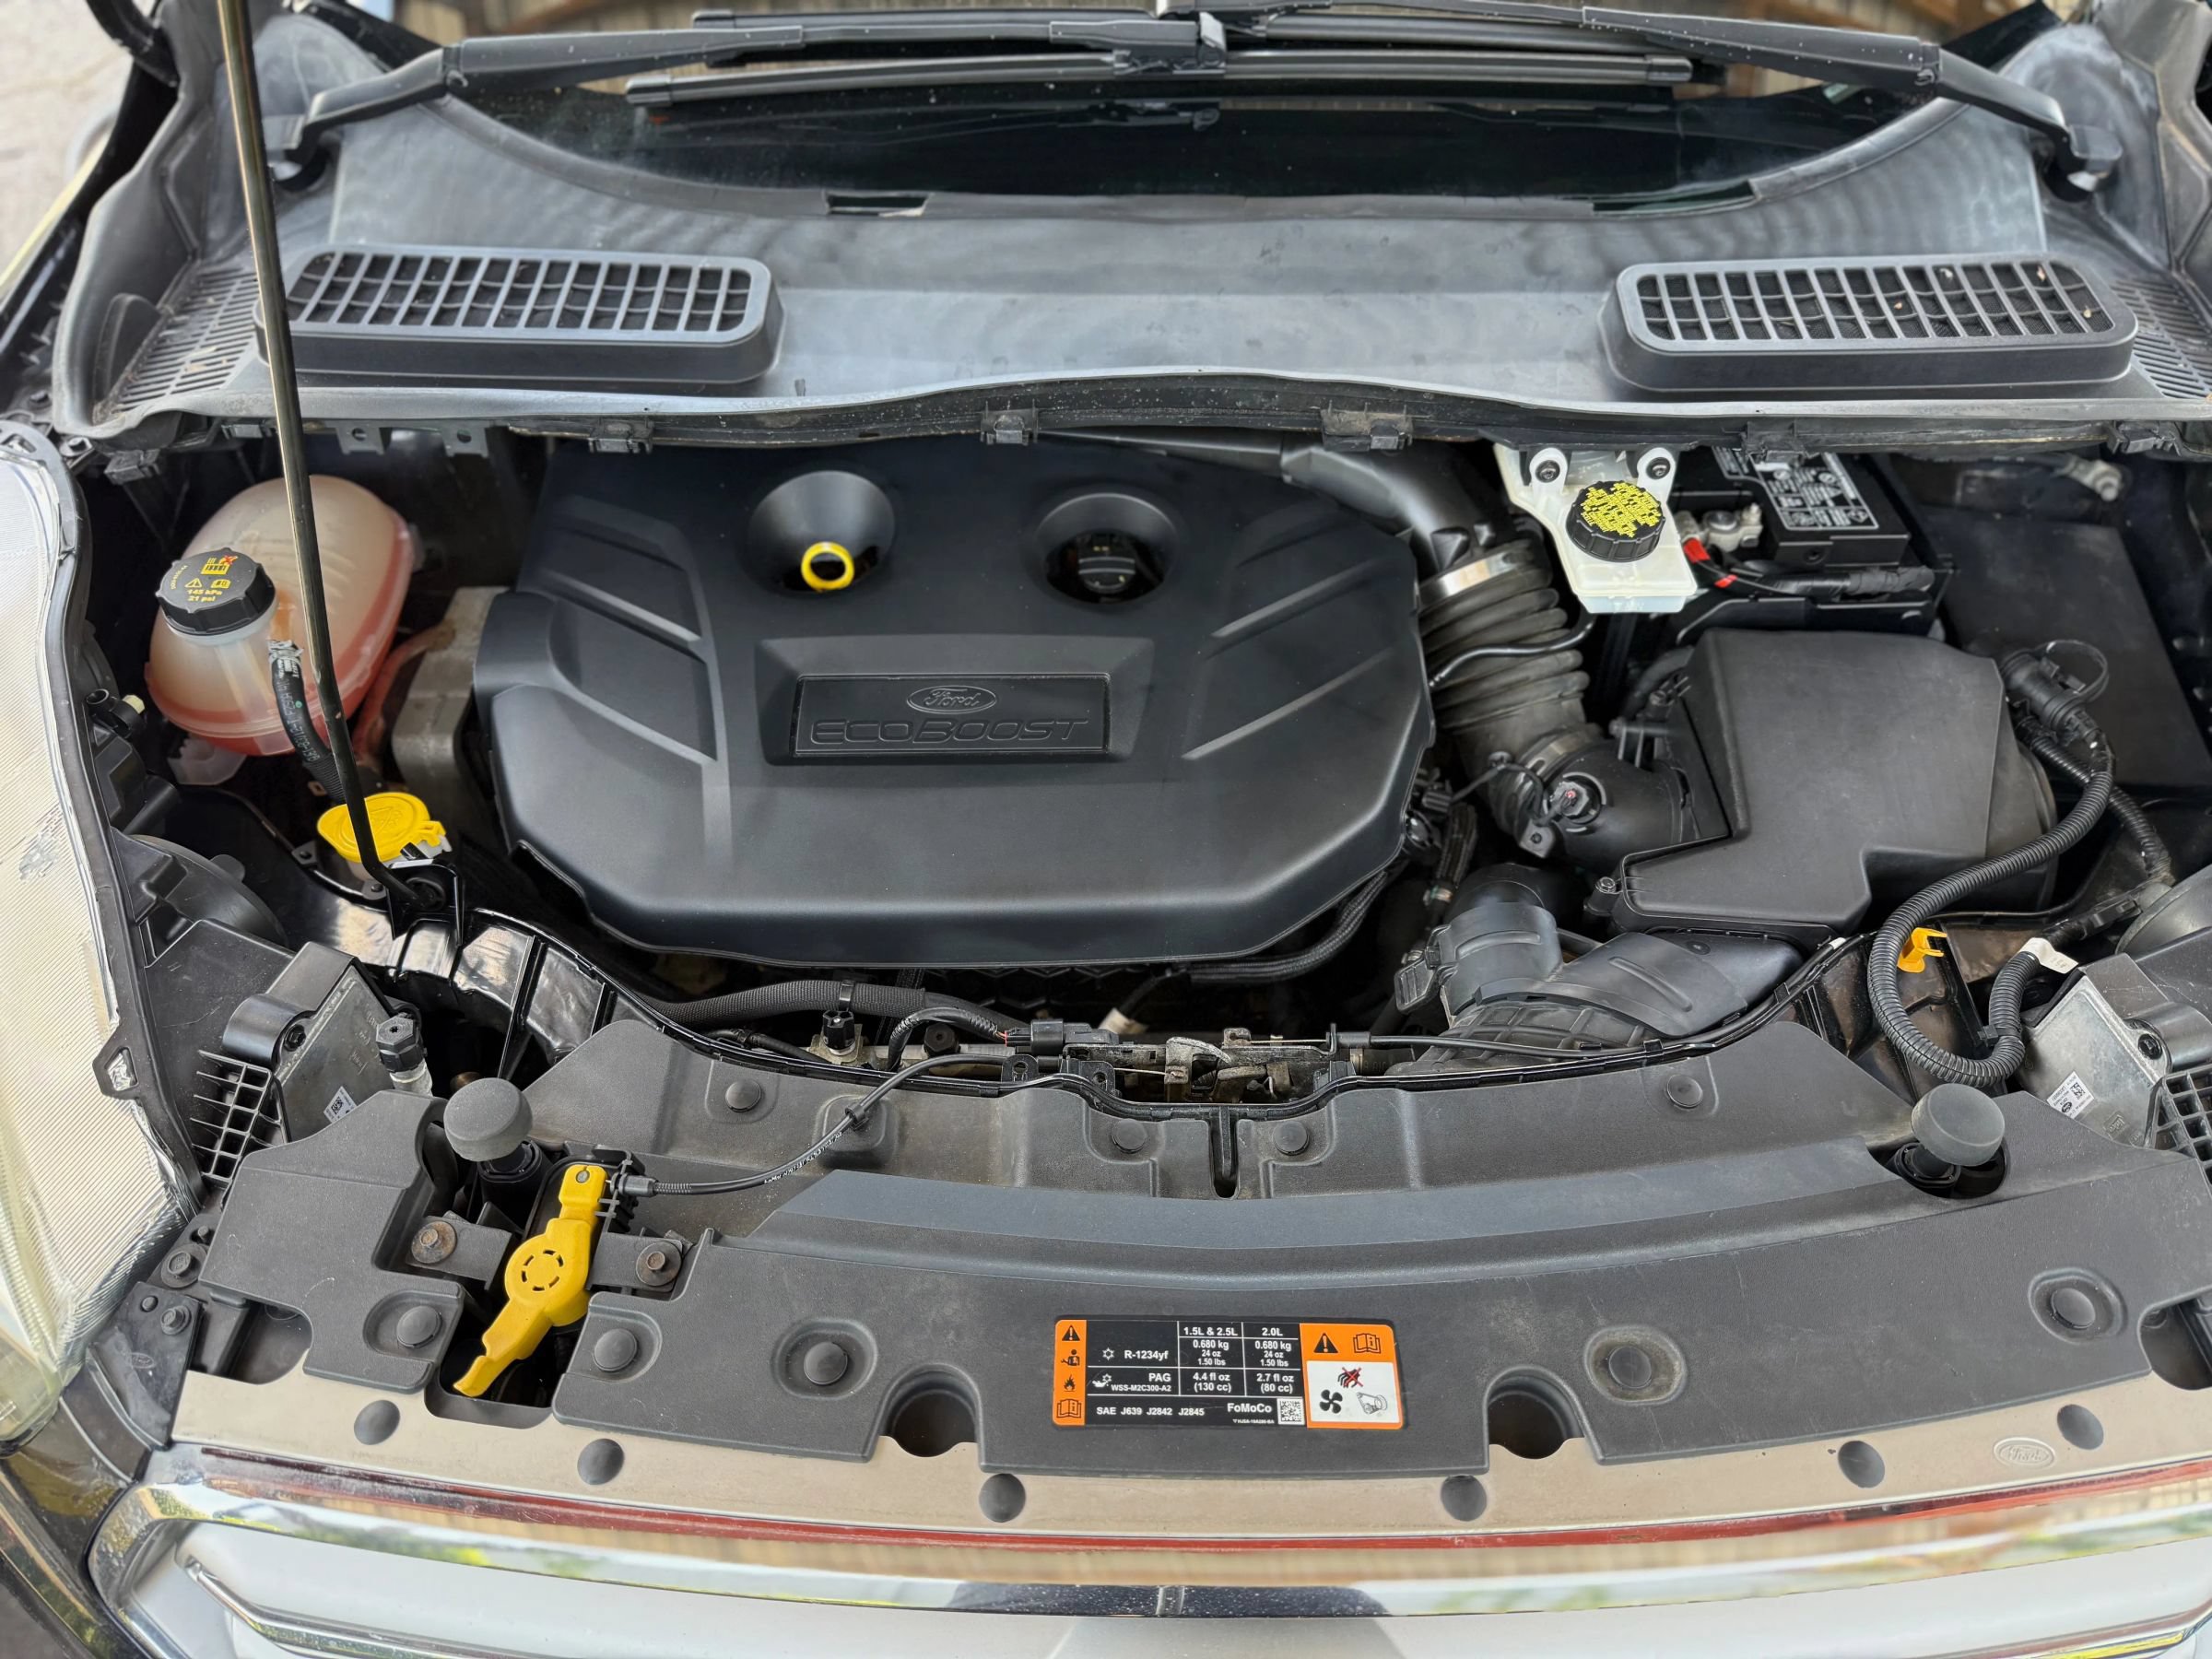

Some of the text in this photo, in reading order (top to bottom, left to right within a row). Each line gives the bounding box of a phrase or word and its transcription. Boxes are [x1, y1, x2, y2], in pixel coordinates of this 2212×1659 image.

[924, 688, 982, 707] Ford
[1183, 1326, 1239, 1336] 1.5L & 2.5L
[1261, 1327, 1284, 1336] 2.0L
[1193, 1339, 1230, 1351] 0.680 kg
[1254, 1340, 1292, 1352] 0.680 kg
[1124, 1349, 1169, 1361] R-1234yf
[1263, 1350, 1274, 1359] 24
[1197, 1358, 1226, 1366] 1.50 lbs
[1260, 1359, 1289, 1367] 1.50 lbs
[1148, 1372, 1171, 1382] PAG
[1193, 1371, 1231, 1382] 4.4 fl oz
[1256, 1372, 1295, 1382] 2.7 fl oz
[1111, 1383, 1171, 1393] WSS-M2C300-A2
[1194, 1382, 1232, 1394] (130 cc)
[1260, 1382, 1294, 1394] (80 cc)
[1096, 1406, 1206, 1417] SAE J639 J2842 J2845
[1227, 1402, 1273, 1413] FoMoCo
